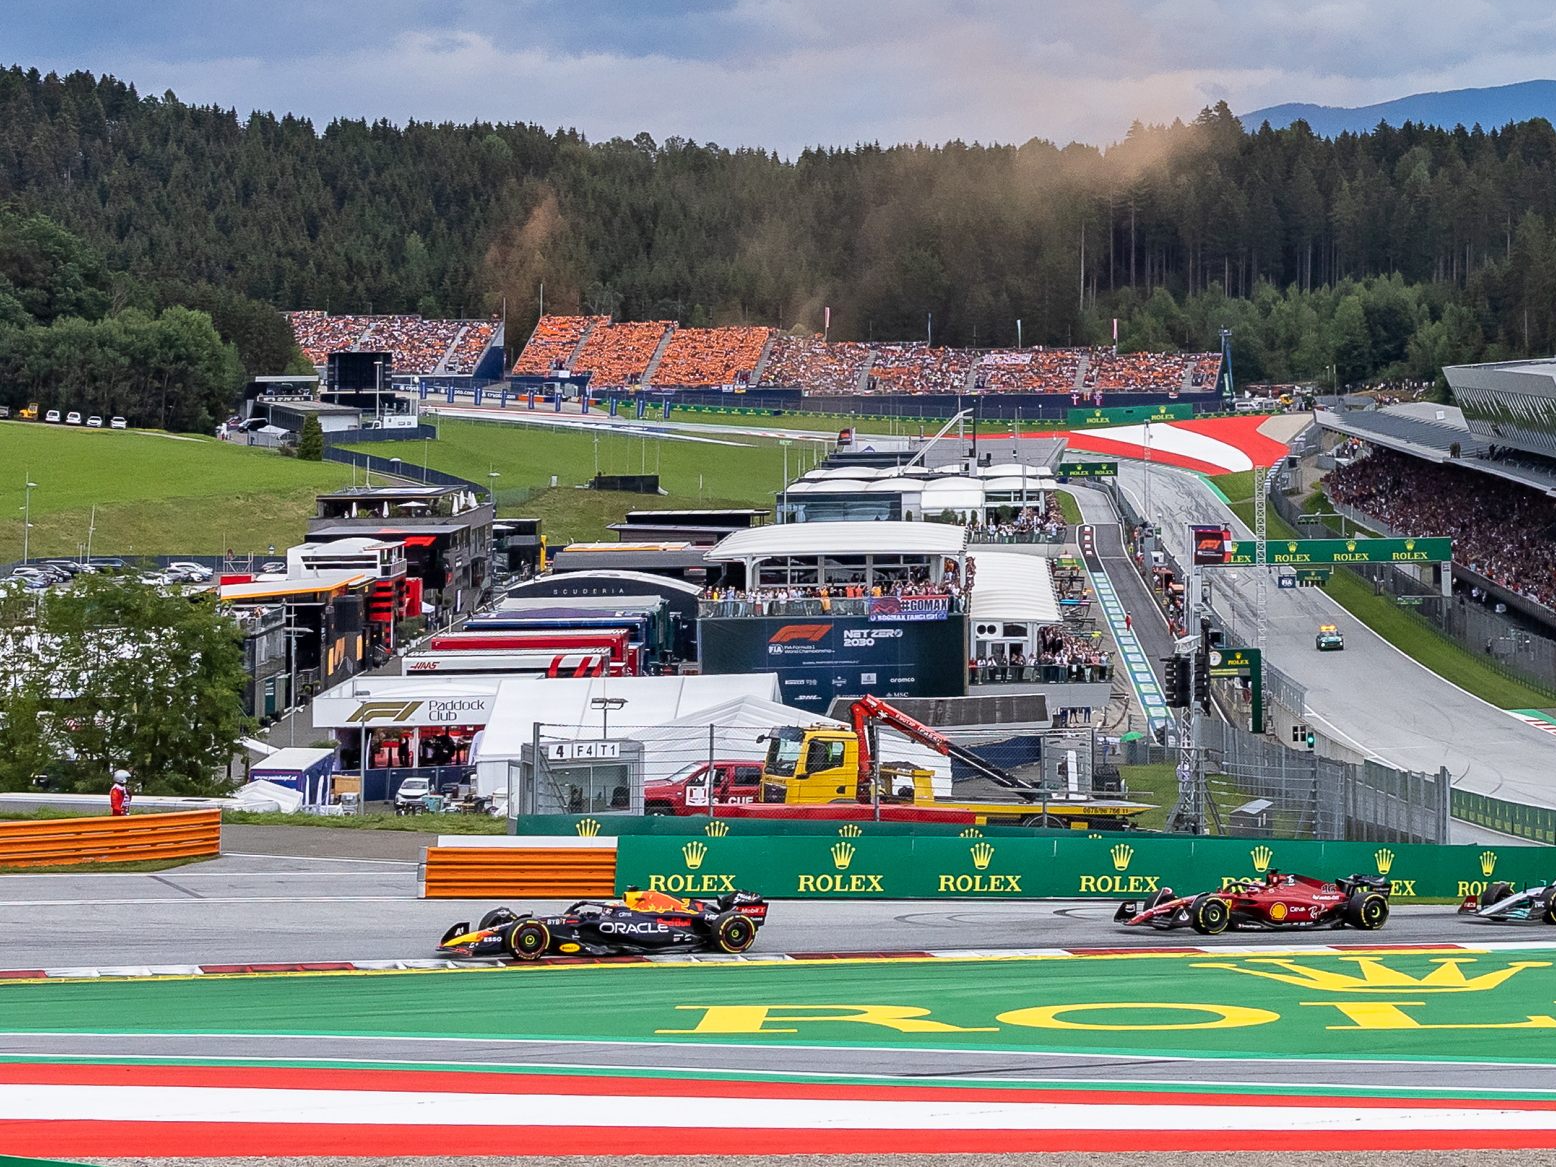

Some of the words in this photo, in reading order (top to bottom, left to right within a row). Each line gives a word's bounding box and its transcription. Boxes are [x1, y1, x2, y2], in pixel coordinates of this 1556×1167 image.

[1151, 413, 1175, 421] ROLEX
[1231, 555, 1252, 563] LEX
[1274, 554, 1310, 562] ROLEX
[1333, 552, 1369, 561] ROLEX
[1392, 551, 1428, 560] ROLEX
[900, 599, 948, 611] #GOMAX
[843, 629, 869, 638] NET
[871, 629, 903, 638] ZERO
[843, 639, 875, 647] 2030
[429, 700, 485, 711] Paddock
[428, 710, 457, 722] Club
[556, 745, 564, 758] 4
[649, 875, 736, 892] ROLEX
[798, 875, 884, 892] ROLEX
[938, 875, 1022, 892] ROLEX
[1079, 875, 1160, 893] ROLEX
[599, 922, 670, 934] ORACLE
